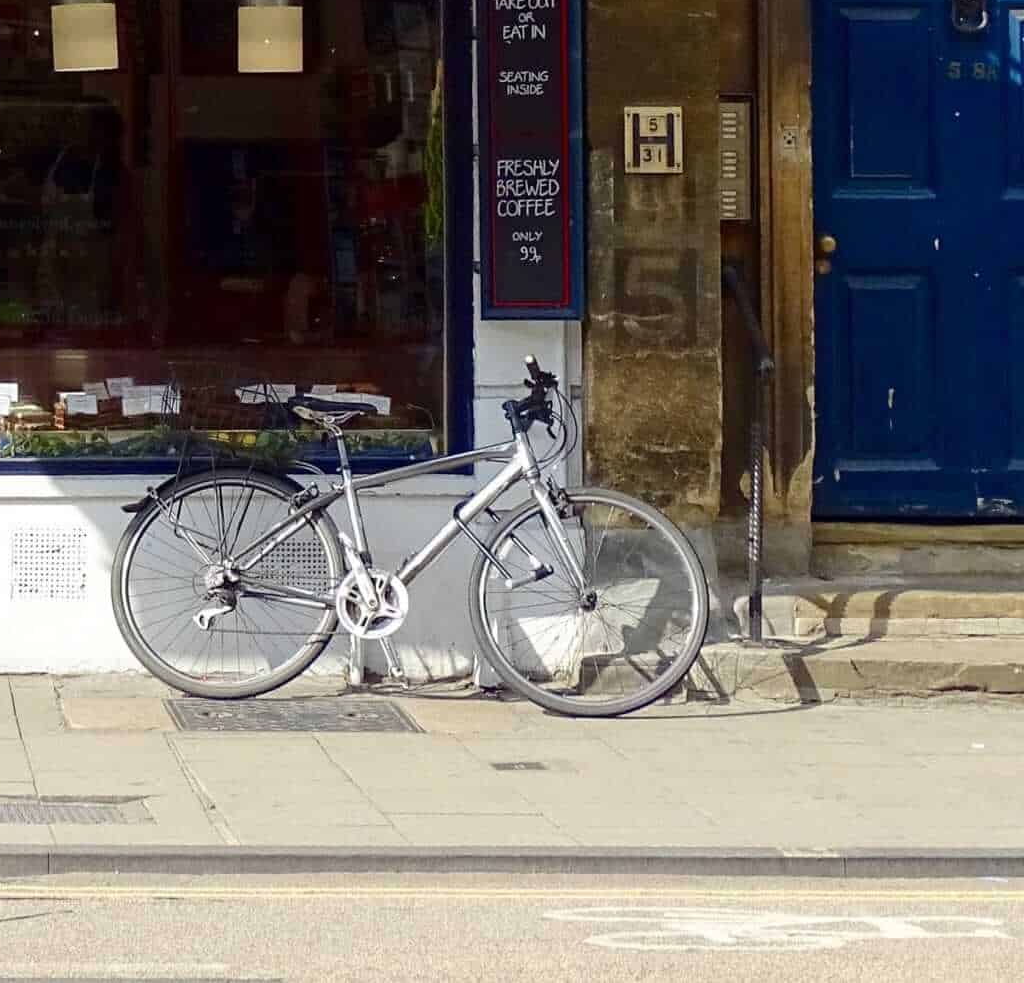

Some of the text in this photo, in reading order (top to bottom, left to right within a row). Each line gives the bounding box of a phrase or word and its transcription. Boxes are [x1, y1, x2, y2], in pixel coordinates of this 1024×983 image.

[518, 11, 536, 23] OR
[502, 24, 546, 40] EAT IN
[499, 71, 549, 83] SEATING
[506, 84, 544, 96] INSIDE
[649, 118, 658, 131] 5
[497, 159, 560, 177] FRESHLY
[496, 179, 560, 196] BREWED
[497, 198, 556, 217] COFFEE
[512, 231, 543, 242] ONLY
